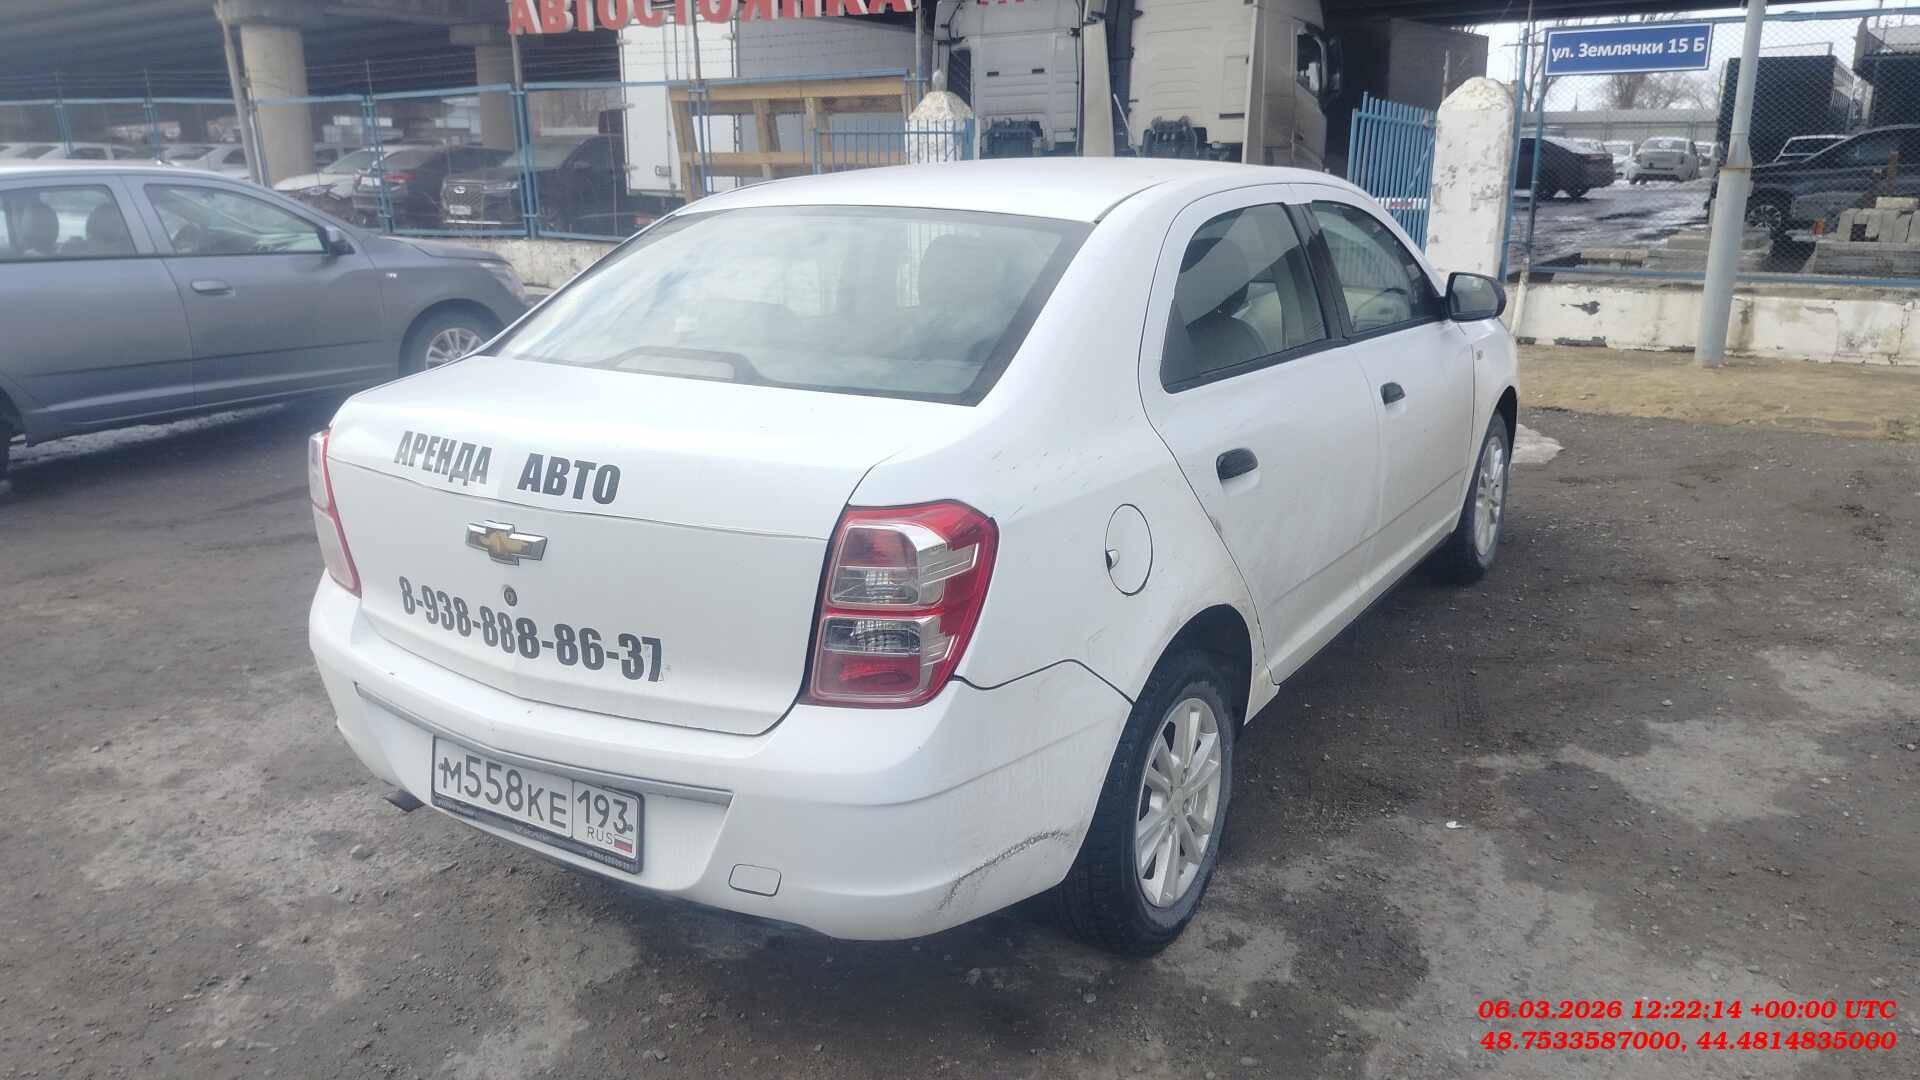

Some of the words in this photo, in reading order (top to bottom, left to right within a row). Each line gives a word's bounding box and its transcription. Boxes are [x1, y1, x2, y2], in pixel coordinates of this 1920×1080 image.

[1551, 47, 1574, 62] ул.
[1578, 42, 1664, 57] Землячки
[1667, 38, 1689, 54] 15
[1693, 36, 1705, 53] Б
[393, 430, 492, 486] АРЕНДА
[516, 453, 621, 504] АВТО
[399, 576, 662, 682] 8-938-888-86-37
[576, 790, 628, 835] 193
[586, 826, 613, 845] RUS
